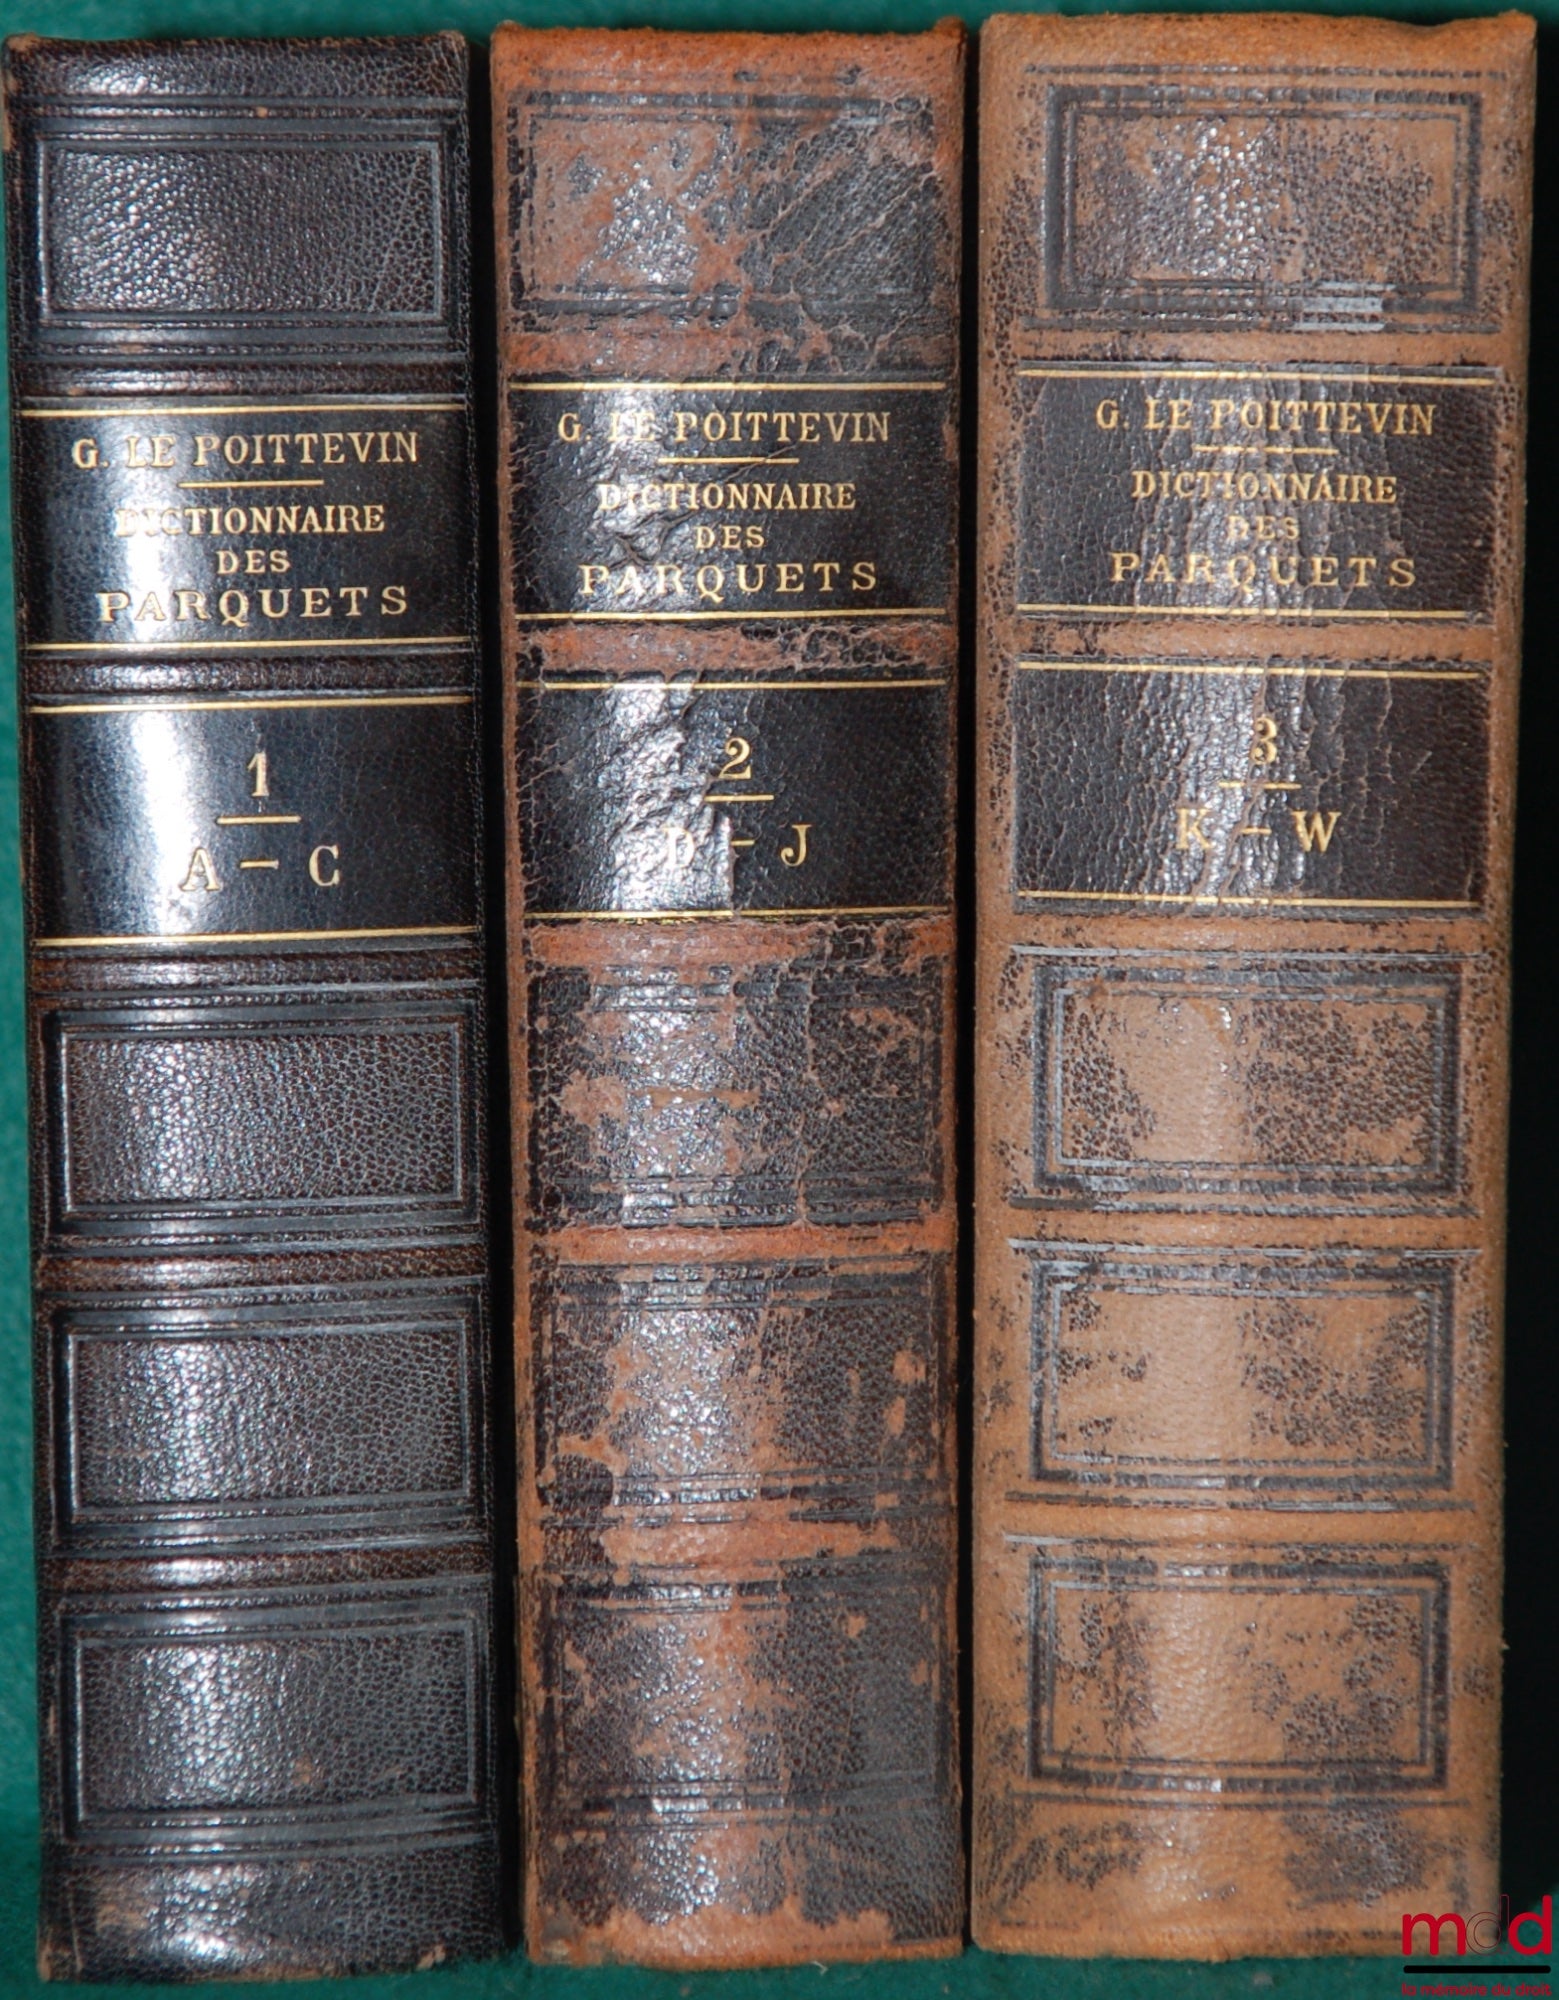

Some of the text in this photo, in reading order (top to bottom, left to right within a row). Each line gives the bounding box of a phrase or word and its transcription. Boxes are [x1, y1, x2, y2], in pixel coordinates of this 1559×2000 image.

[557, 411, 890, 443] G. LE POITTEVIN
[1096, 399, 1437, 435] G. LE POITTEVIN
[71, 431, 418, 469] G. LE POITTEVIN
[598, 482, 856, 511] DICTIONNAIRE
[1131, 470, 1398, 503] DICTIONNAIRE
[113, 505, 386, 537] DICTIONNAIRE
[694, 525, 765, 550] DES
[1227, 514, 1300, 541] DES
[216, 549, 291, 575] DES
[1110, 552, 1417, 594] PARQUETS
[579, 562, 878, 603] PARQUETS
[98, 585, 408, 628] PARQUETS
[717, 737, 753, 780] 2
[1251, 717, 1279, 765] 3
[247, 751, 270, 798] 1
[779, 824, 812, 867] J
[1175, 808, 1216, 851] K
[1291, 810, 1342, 853] W
[180, 848, 221, 892] A
[308, 845, 341, 887] C
